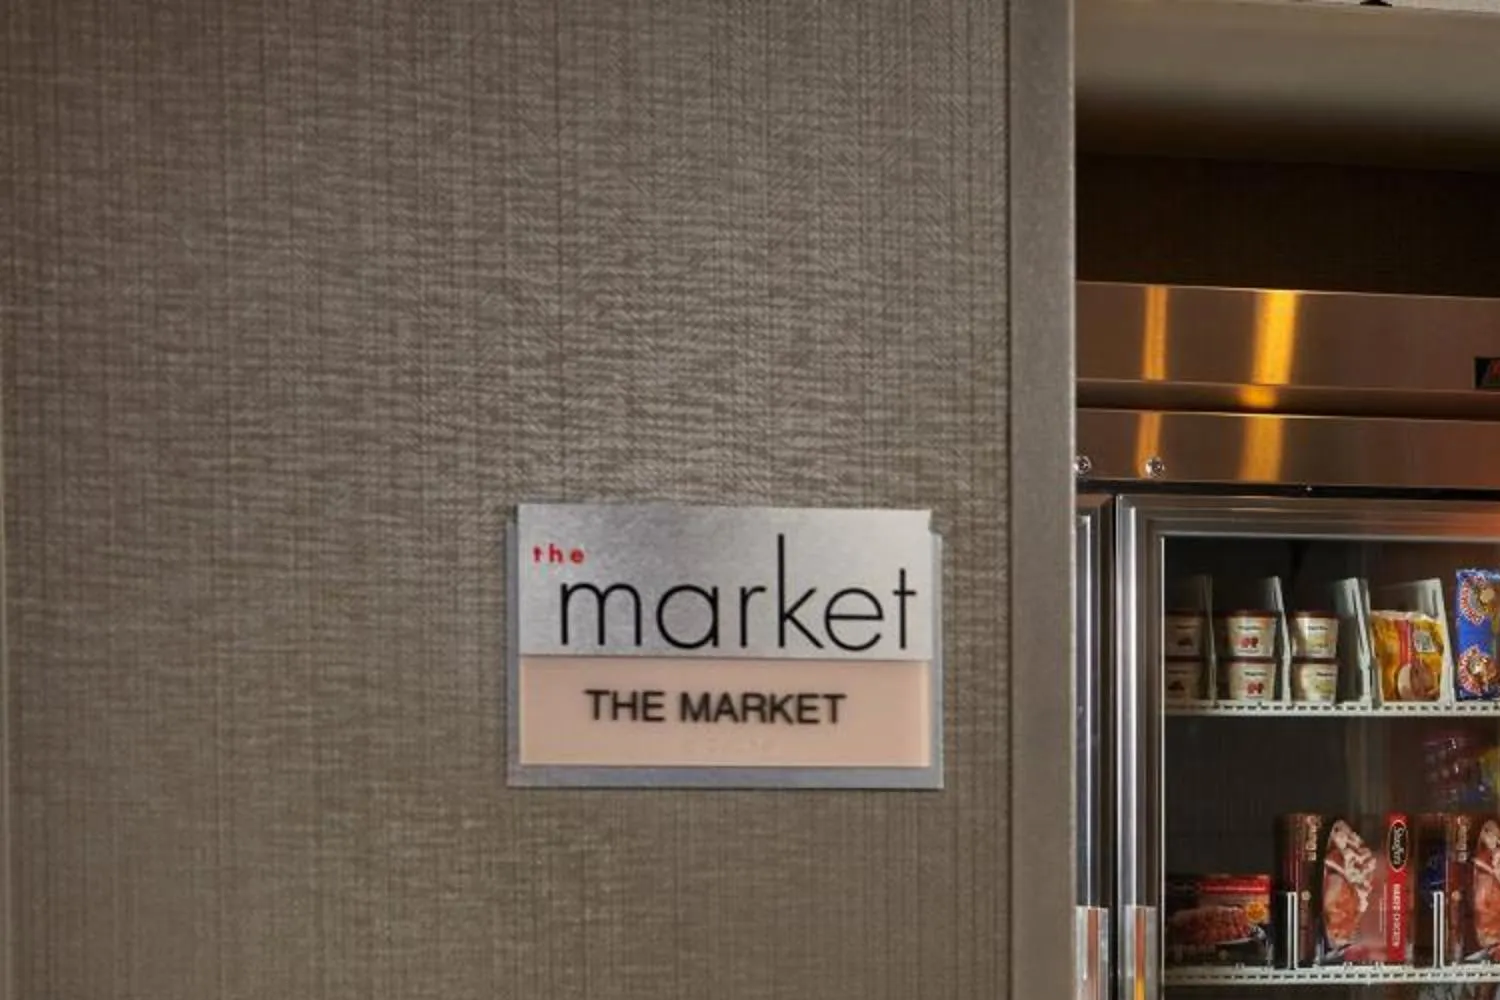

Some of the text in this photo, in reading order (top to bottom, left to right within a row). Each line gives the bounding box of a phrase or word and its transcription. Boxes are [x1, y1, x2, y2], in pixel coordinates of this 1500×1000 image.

[532, 544, 586, 564] the
[560, 533, 917, 652] market
[584, 689, 847, 725] THE MARKET
